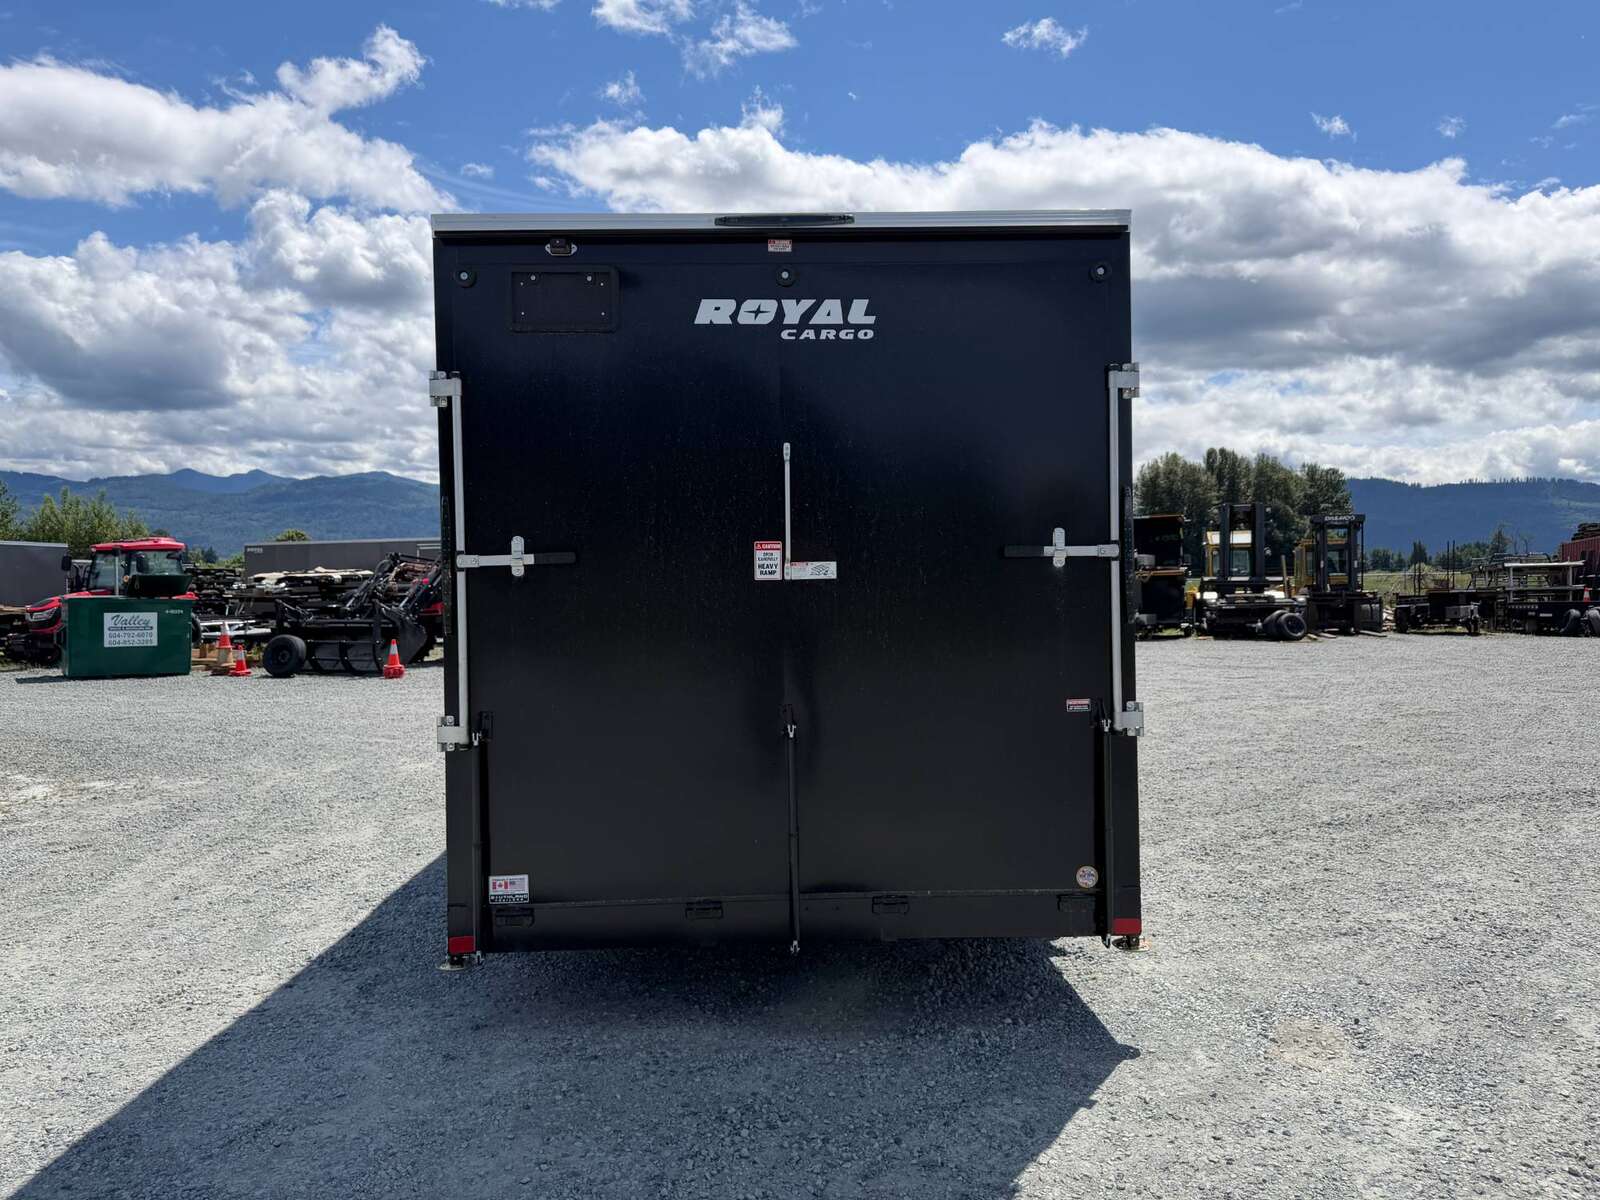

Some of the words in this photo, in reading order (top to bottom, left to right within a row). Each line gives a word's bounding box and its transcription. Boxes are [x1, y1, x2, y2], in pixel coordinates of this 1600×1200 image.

[694, 299, 877, 325] ROYAL
[780, 329, 875, 340] CARGO
[111, 614, 151, 626] Valley
